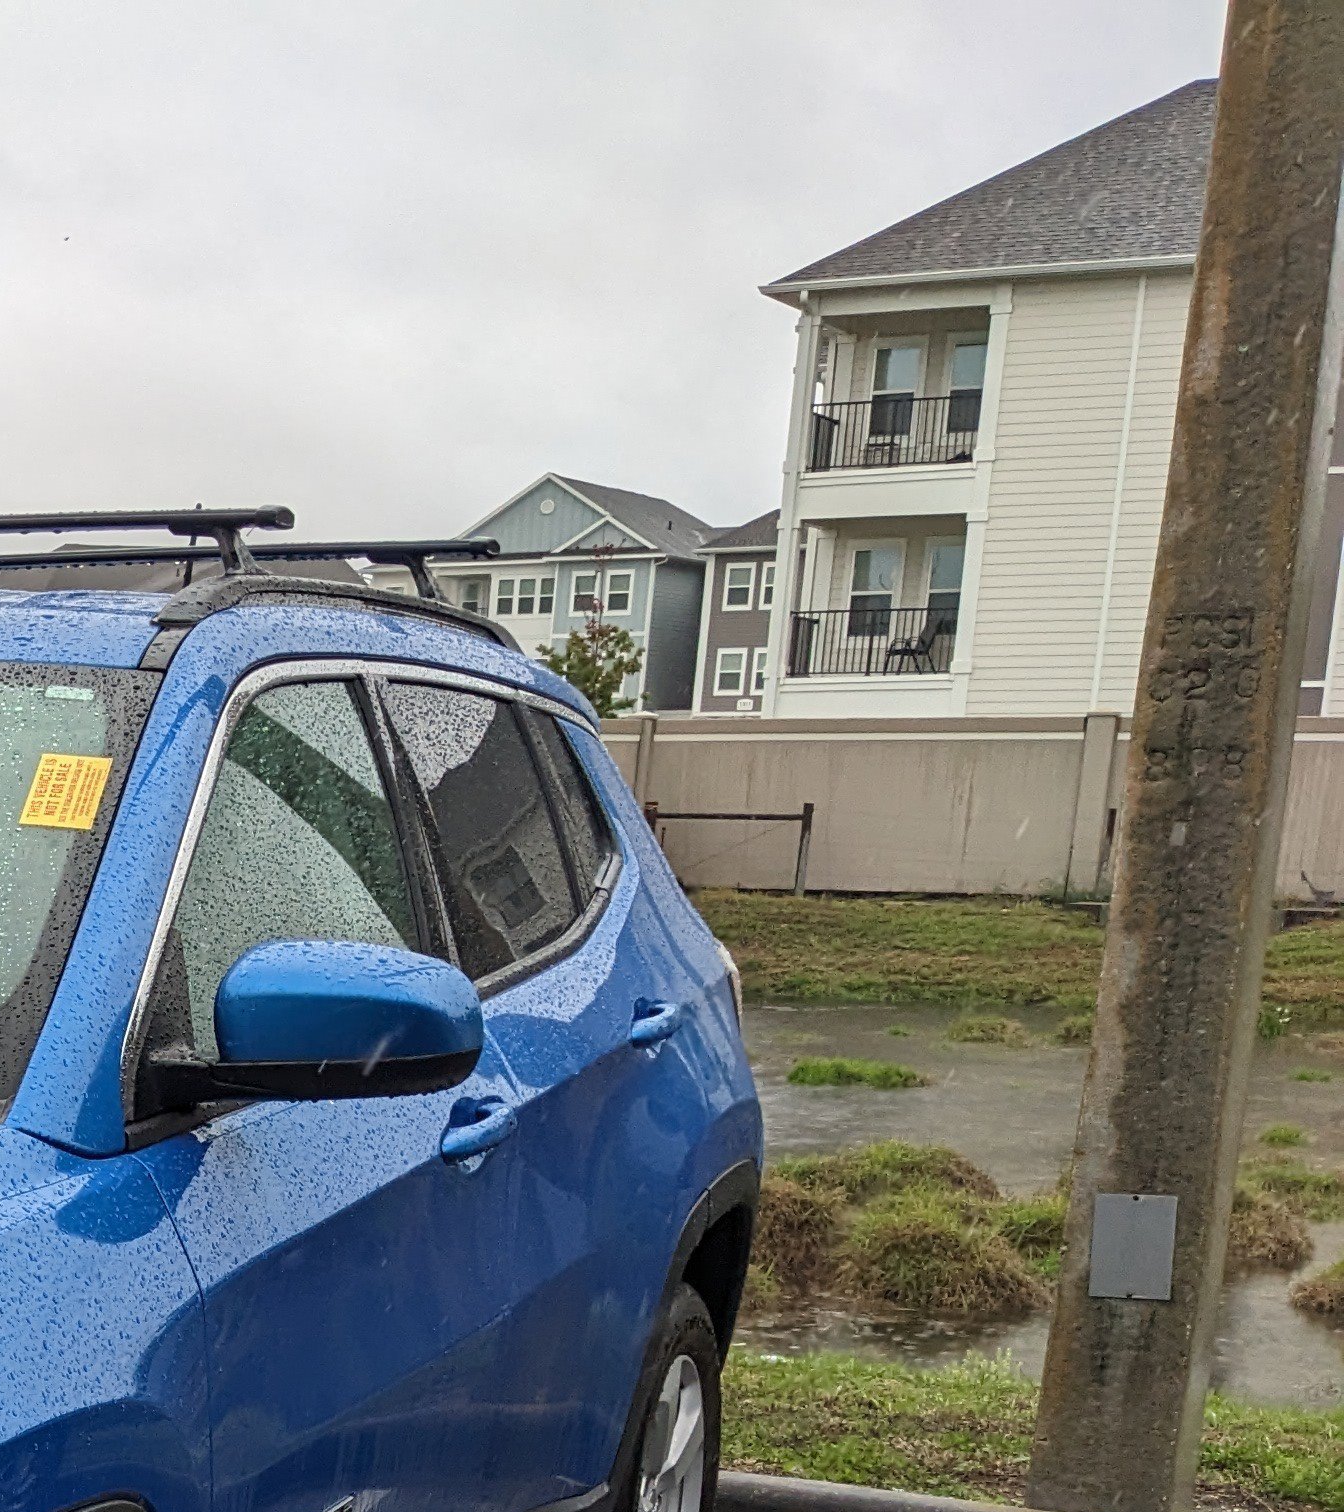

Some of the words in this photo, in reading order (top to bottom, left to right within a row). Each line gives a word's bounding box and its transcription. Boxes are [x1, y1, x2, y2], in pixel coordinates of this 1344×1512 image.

[44, 758, 57, 766] IS
[55, 763, 72, 782] SALE
[34, 768, 54, 798] VEHICLE
[49, 783, 65, 798] FOR
[26, 800, 43, 817] THIS
[43, 800, 60, 816] NOT
